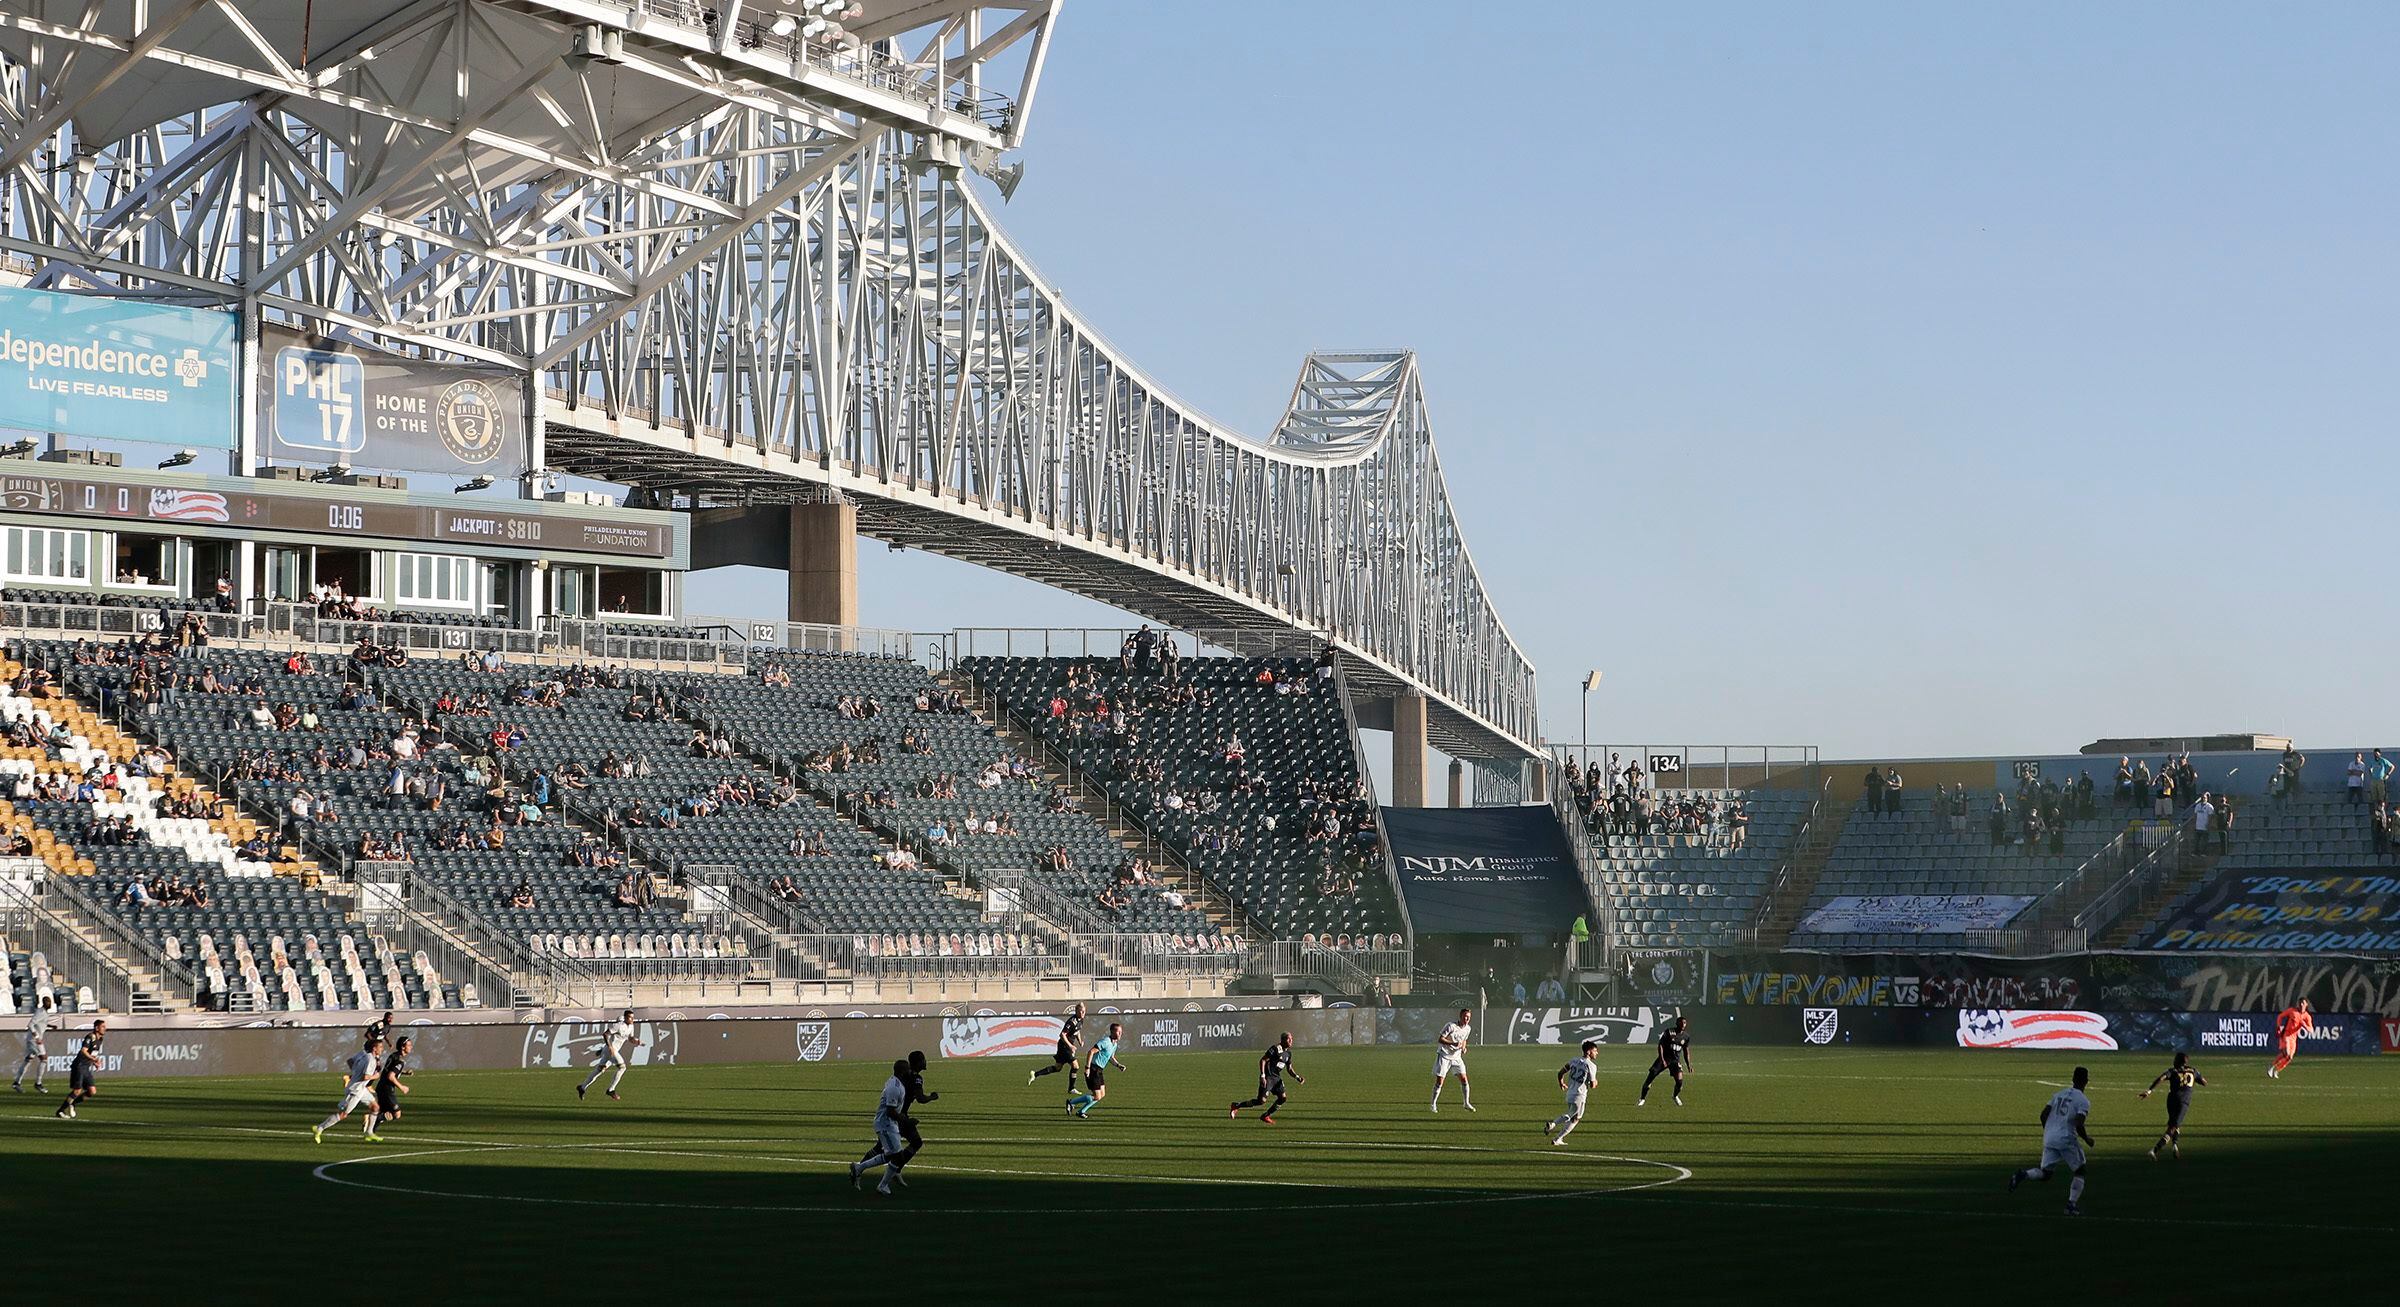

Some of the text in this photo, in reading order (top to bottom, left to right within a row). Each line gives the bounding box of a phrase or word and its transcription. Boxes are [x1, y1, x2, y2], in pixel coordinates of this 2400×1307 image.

[0, 329, 168, 377] dependence
[286, 356, 352, 403] PHL
[29, 376, 168, 402] LIVE FEARLESS
[375, 394, 427, 414] HOME
[440, 383, 501, 421] PHILADELPHIA
[457, 404, 482, 415] UNION
[318, 403, 353, 443] 17
[376, 415, 428, 433] OF THE
[9, 479, 38, 491] UNION
[84, 485, 96, 509] 0
[118, 487, 129, 511] 0
[329, 505, 363, 529] 0:06
[507, 518, 541, 540] $810
[584, 525, 627, 535] PHILADELPHIA
[583, 532, 647, 547] FOUNDATION
[445, 630, 467, 647] 131
[753, 625, 774, 641] 132
[1652, 756, 1679, 772] 134
[1400, 856, 1490, 873] NJM
[1491, 863, 1535, 871] Group
[2213, 903, 2380, 924] Happen
[1716, 973, 1891, 1006] EVERYONE
[2181, 964, 2333, 1013] THANK
[1806, 1011, 1825, 1020] MLS
[800, 1025, 818, 1035] MLS
[1154, 1019, 1179, 1032] MATCH
[2218, 1018, 2251, 1032] MATCH
[1141, 1032, 1192, 1047] PRESENTED BY
[2201, 1032, 2269, 1047] PRESENTED BY
[131, 1043, 203, 1061] THOMAS'
[108, 1055, 123, 1071] BY
